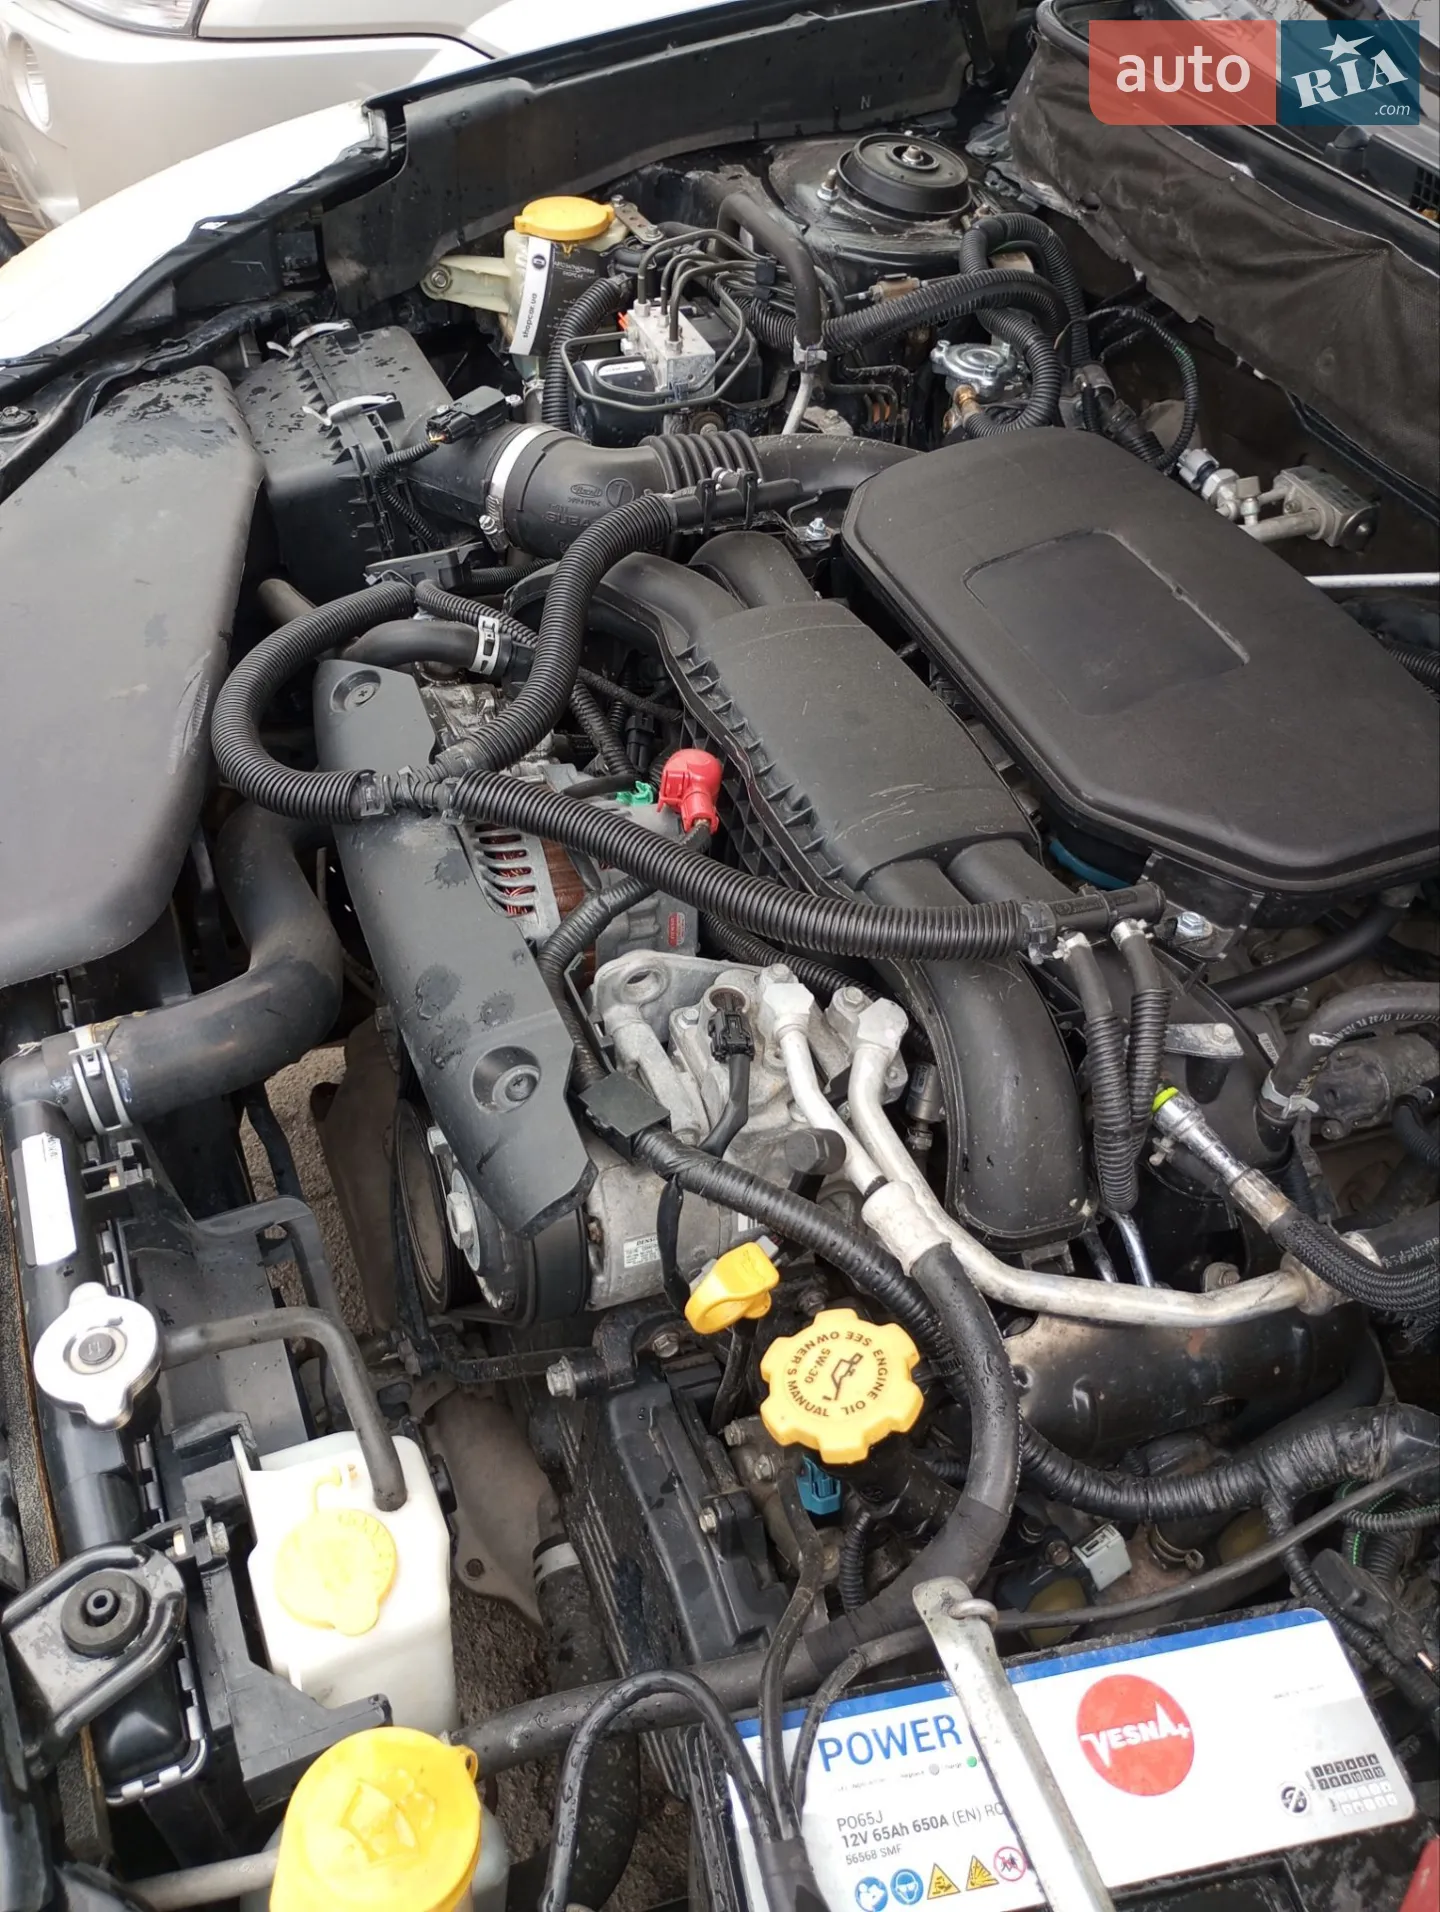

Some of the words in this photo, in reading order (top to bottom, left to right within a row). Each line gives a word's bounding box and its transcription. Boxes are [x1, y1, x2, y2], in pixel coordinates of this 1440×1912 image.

[522, 292, 538, 339] shopcar.ua
[545, 510, 594, 527] SUBA
[845, 1330, 873, 1347] SEE
[867, 1348, 889, 1401] ENGINE
[787, 1379, 830, 1418] MANUAL
[840, 1399, 867, 1416] OIL
[817, 1713, 963, 1772] POWER
[841, 1830, 869, 1849] 12V
[872, 1822, 910, 1842] 65Ah
[912, 1814, 949, 1833] 650A
[952, 1808, 982, 1828] (EN)
[845, 1849, 878, 1866] 56568
